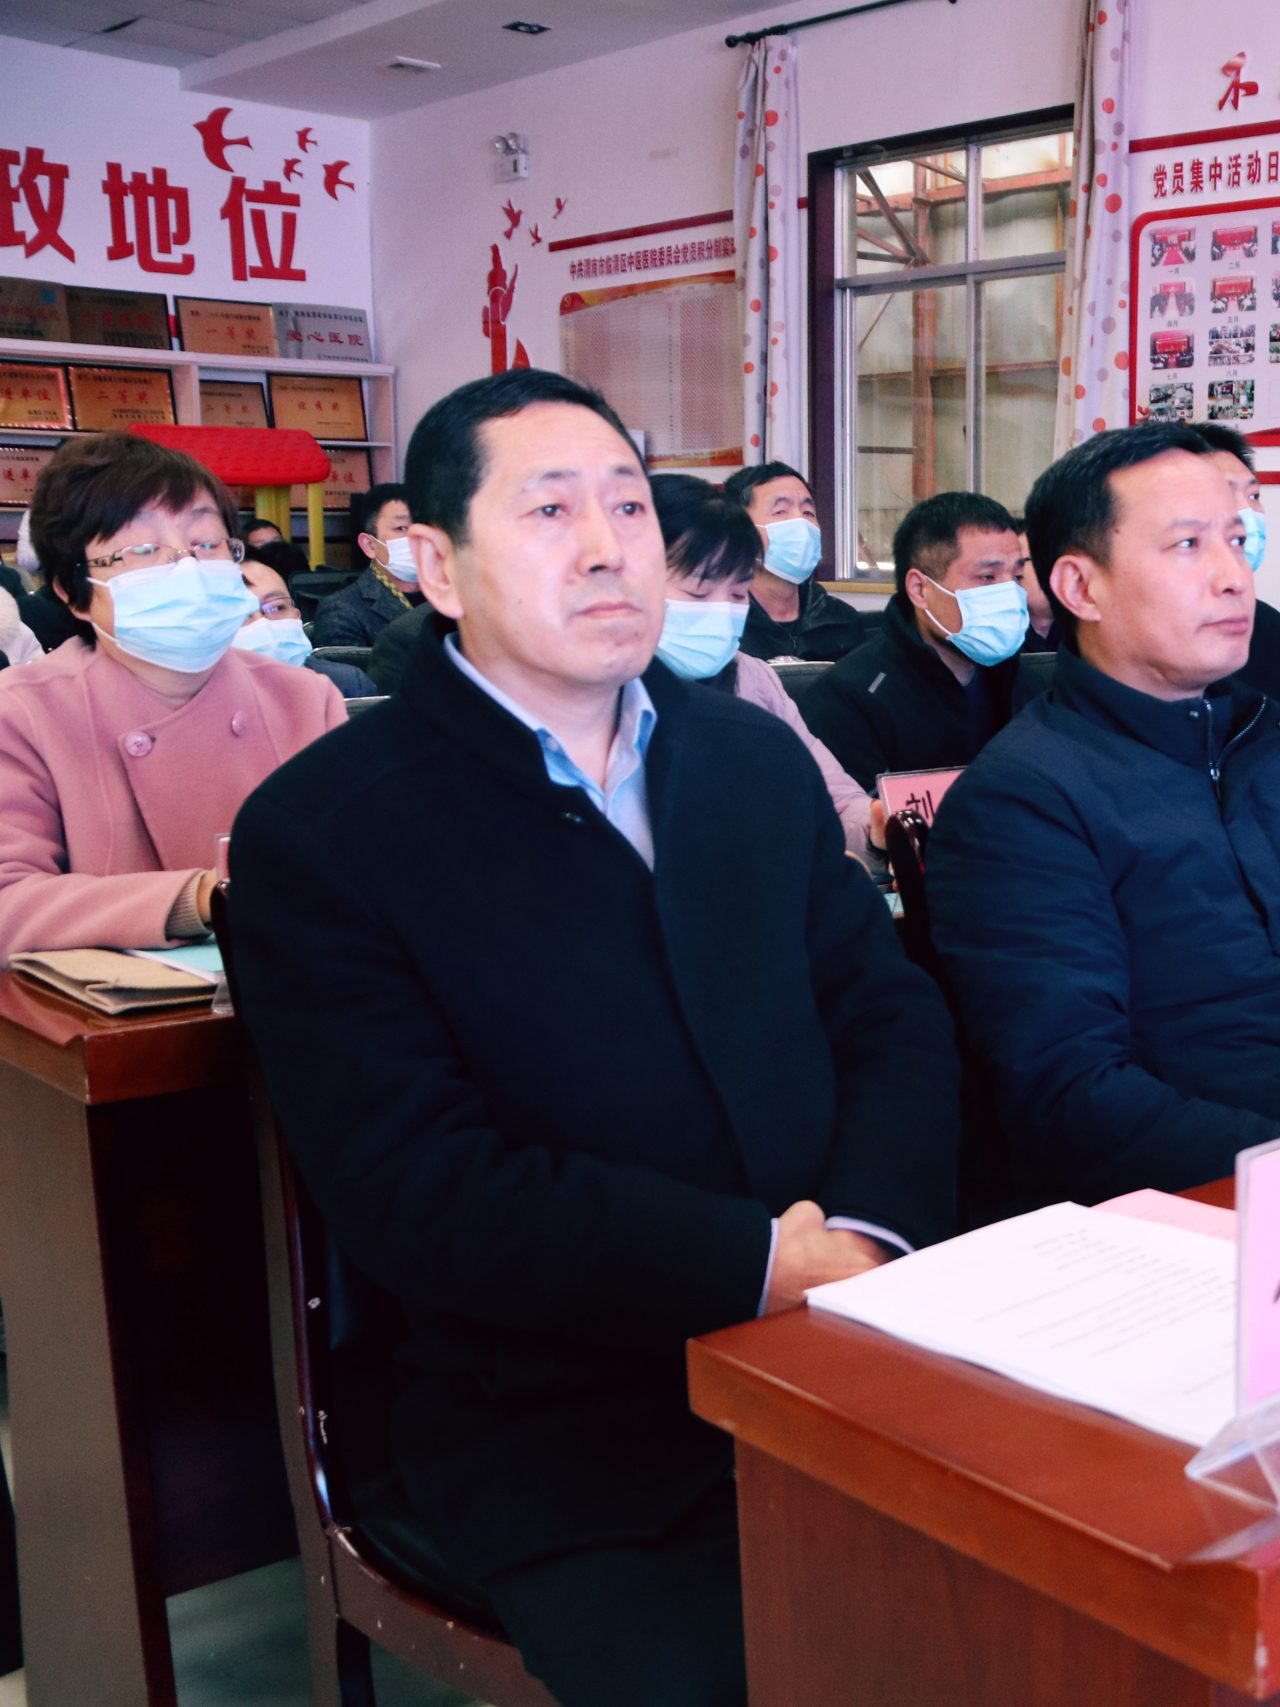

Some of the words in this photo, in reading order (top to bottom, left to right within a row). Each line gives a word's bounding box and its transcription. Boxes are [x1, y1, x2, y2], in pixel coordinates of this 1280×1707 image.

[0, 146, 306, 282] 政地位
[1229, 262, 1240, 270] 二月
[1228, 315, 1239, 323] 五月
[1167, 320, 1179, 328] 四月
[286, 330, 365, 346] 爱心医院
[1167, 372, 1178, 380] 七月
